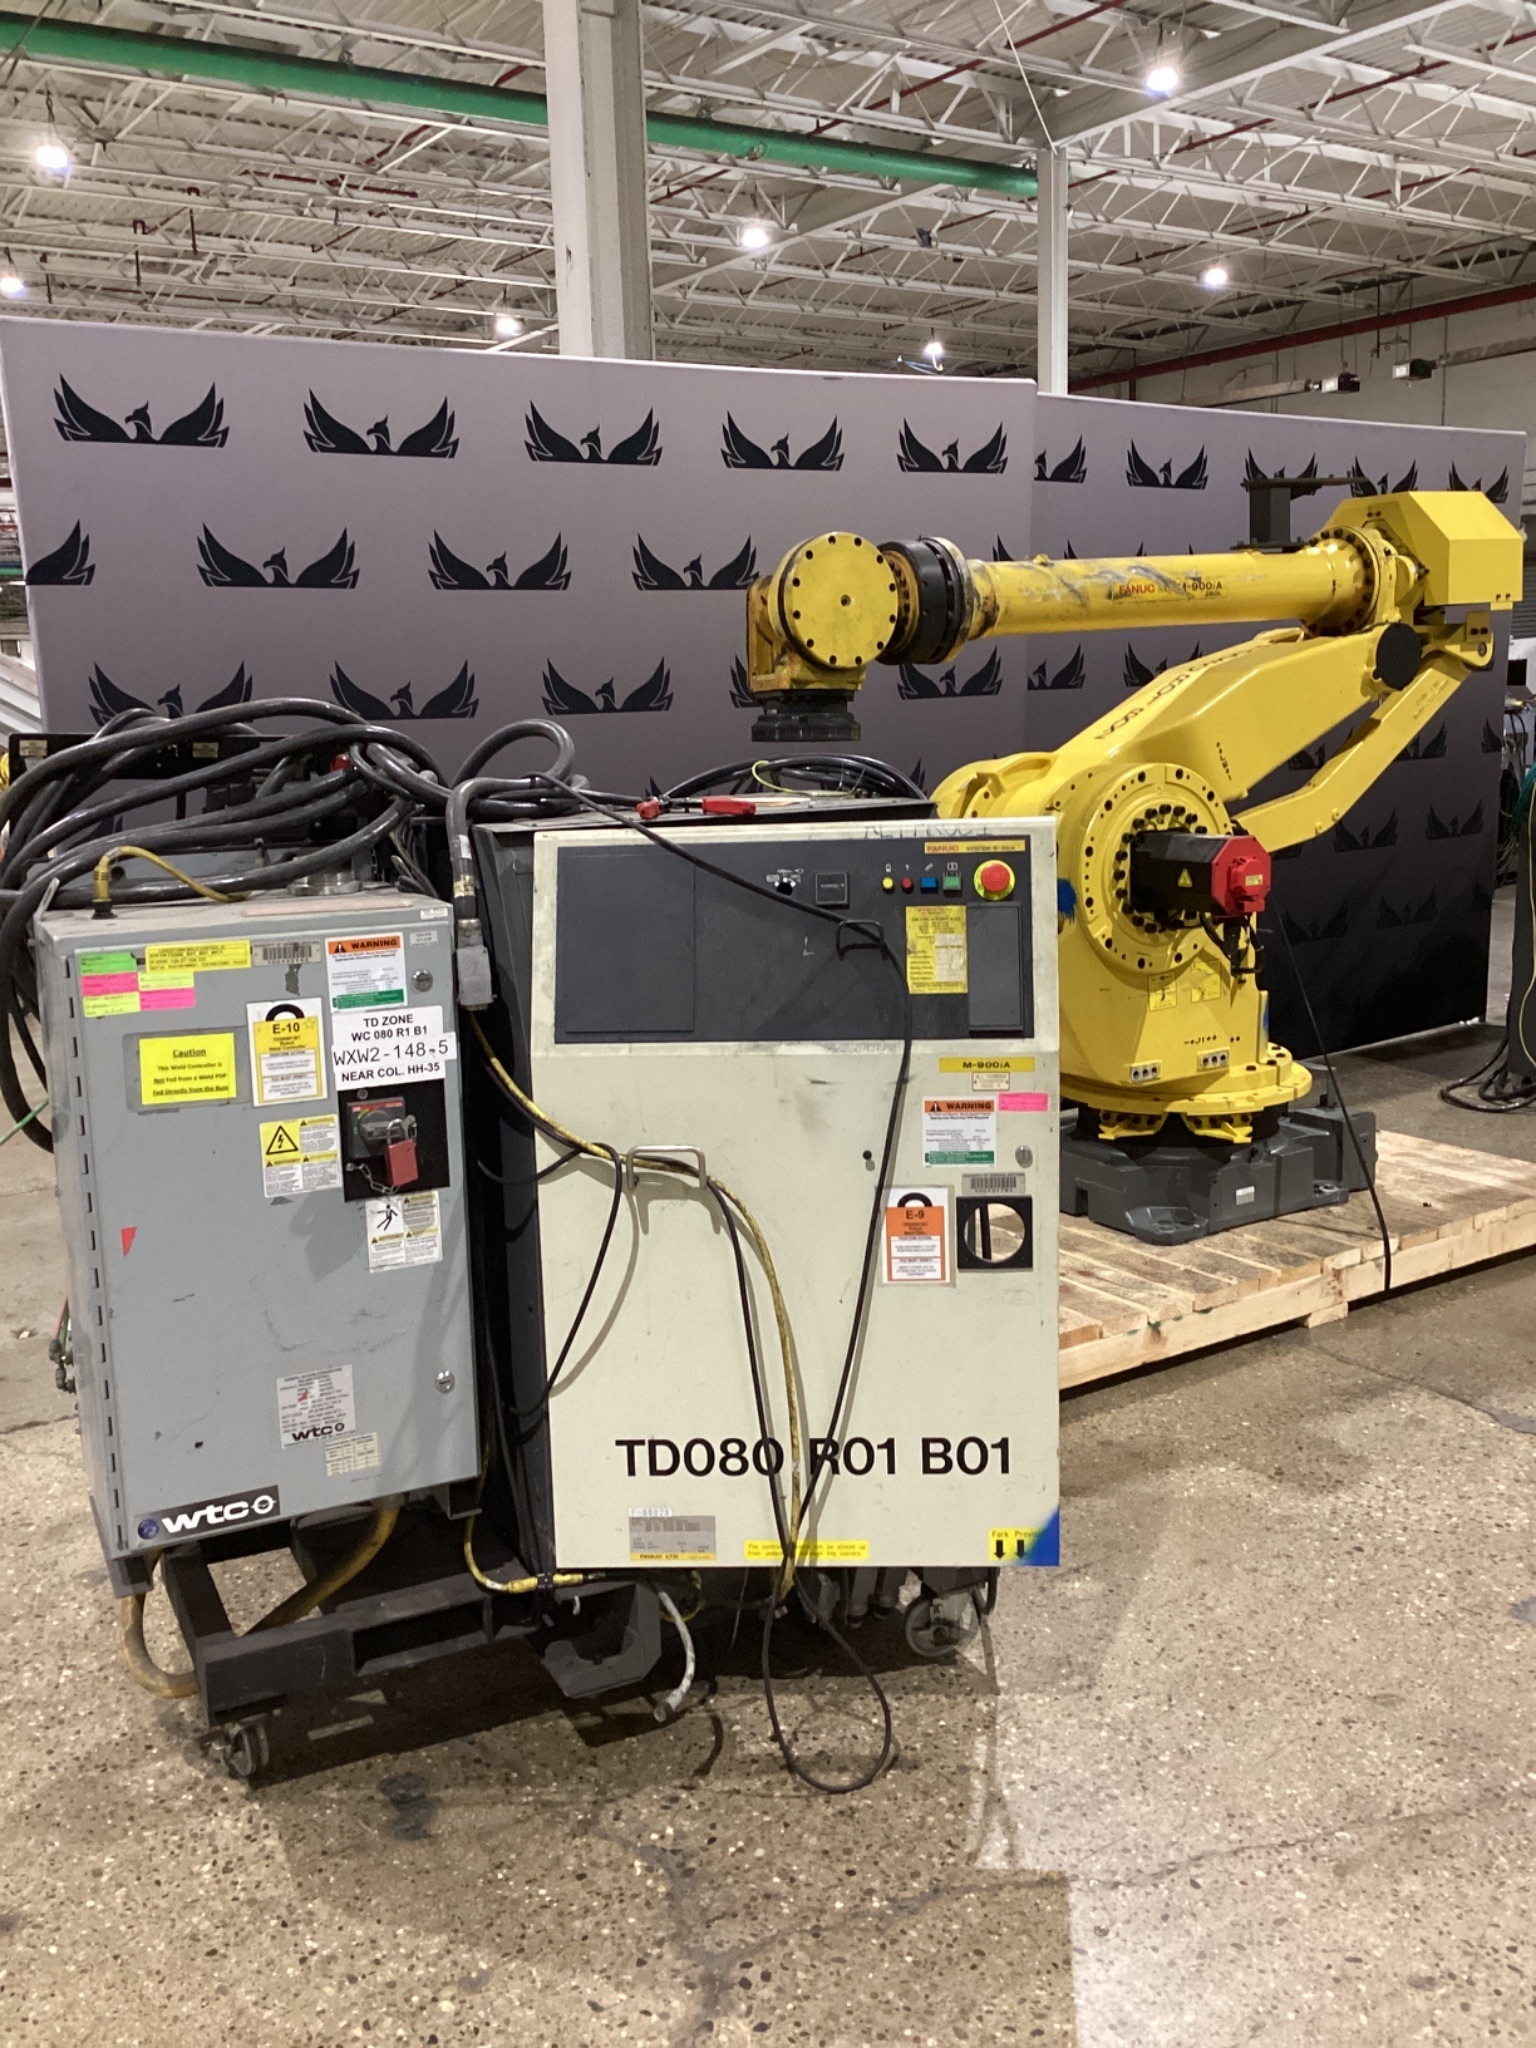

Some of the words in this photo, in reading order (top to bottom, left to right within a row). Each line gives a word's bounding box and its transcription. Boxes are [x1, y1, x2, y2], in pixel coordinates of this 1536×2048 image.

[1118, 583, 1155, 596] FANUC
[350, 938, 398, 950] WARNING
[363, 1017, 379, 1028] TD
[382, 1013, 414, 1026] ZONE
[272, 1022, 301, 1034] E-10
[351, 1032, 371, 1042] WC
[373, 1029, 394, 1040] 080
[396, 1027, 411, 1038] R1
[413, 1025, 428, 1036] B1
[172, 1048, 207, 1058] Caution
[962, 1060, 1011, 1069] M-900iA
[341, 1069, 375, 1082] NEAR
[377, 1066, 405, 1078] COL.
[407, 1062, 441, 1074] HH-35
[946, 1101, 992, 1110] WARNING
[906, 1209, 925, 1220] E-9
[291, 1422, 345, 1441] wtco
[615, 1437, 784, 1477] TD080
[809, 1436, 896, 1476] R01
[921, 1436, 1009, 1475] B01
[161, 1494, 277, 1534] wtco
